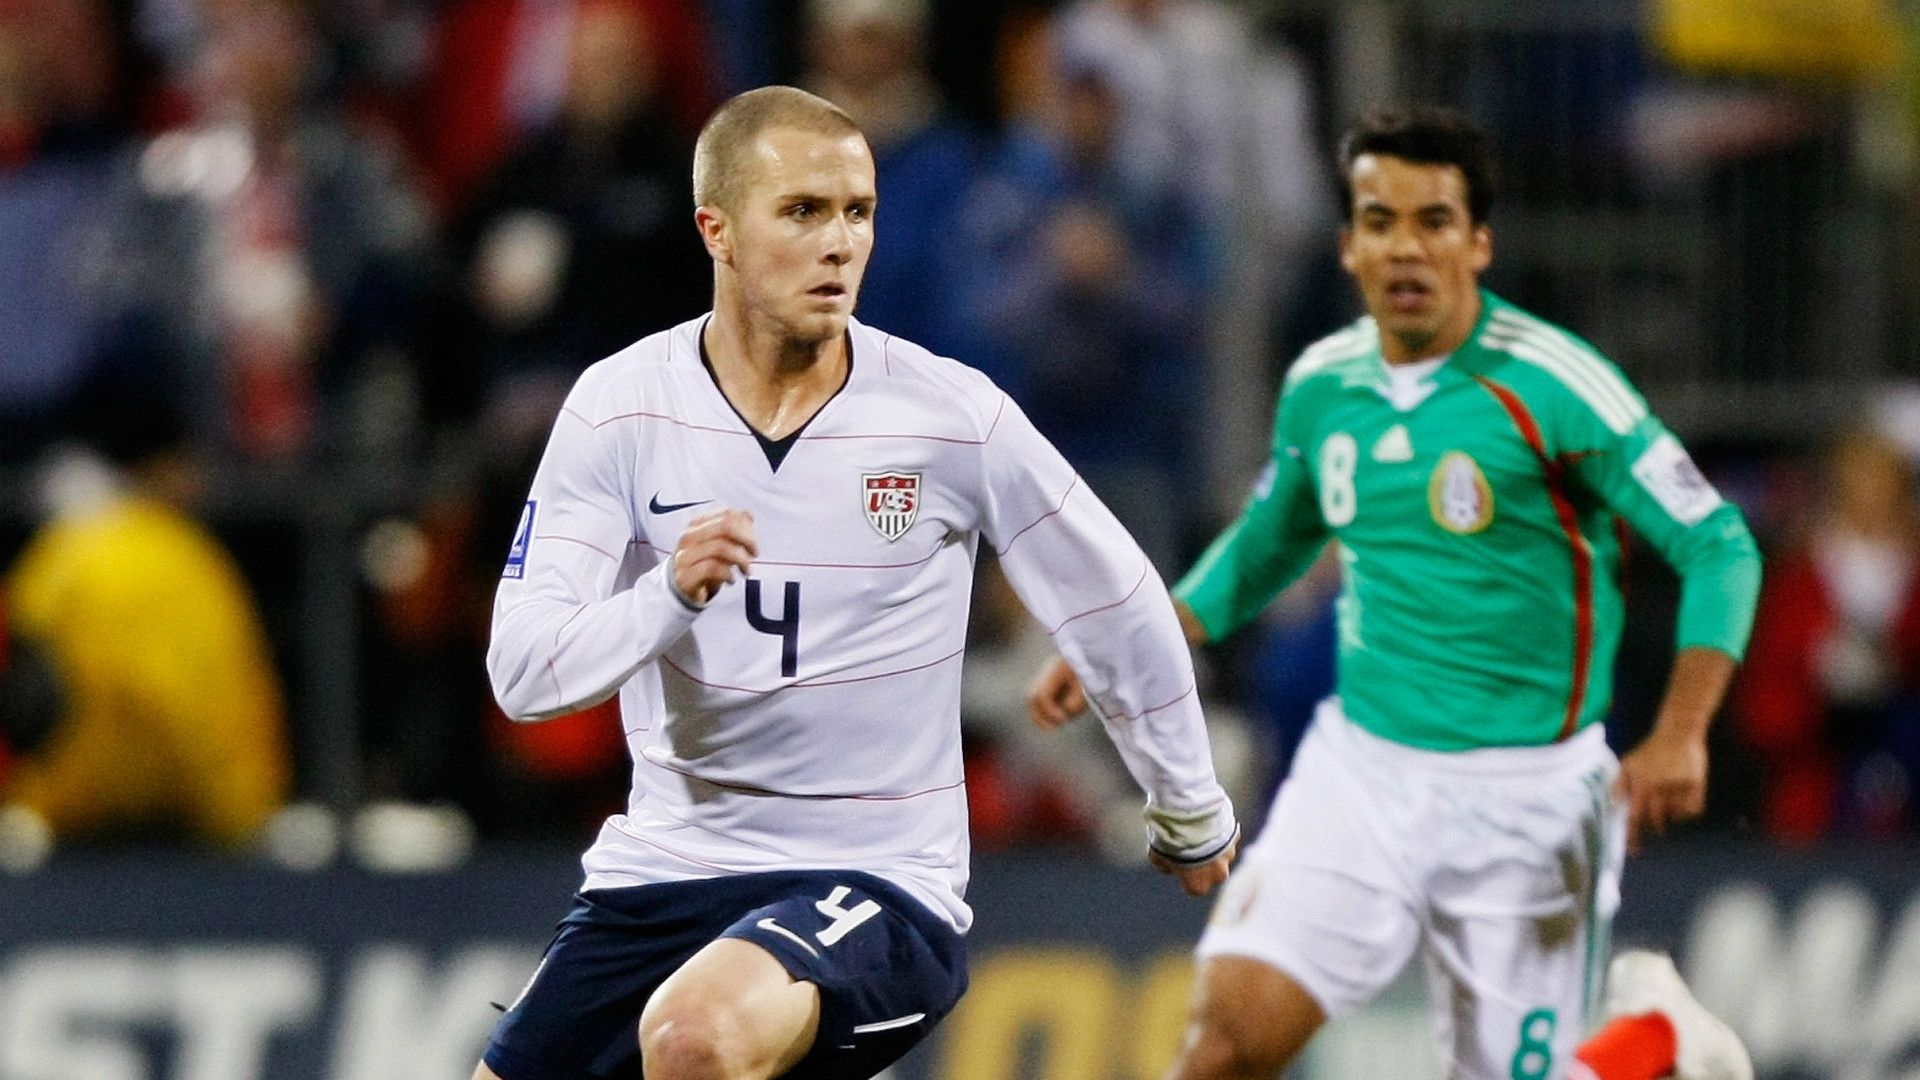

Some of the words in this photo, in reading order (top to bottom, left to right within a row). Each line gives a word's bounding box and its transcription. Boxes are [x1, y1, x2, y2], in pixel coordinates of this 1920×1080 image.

[1318, 431, 1358, 527] 8
[744, 579, 800, 678] 4
[814, 884, 882, 947] 4
[1510, 1007, 1557, 1080] 8
